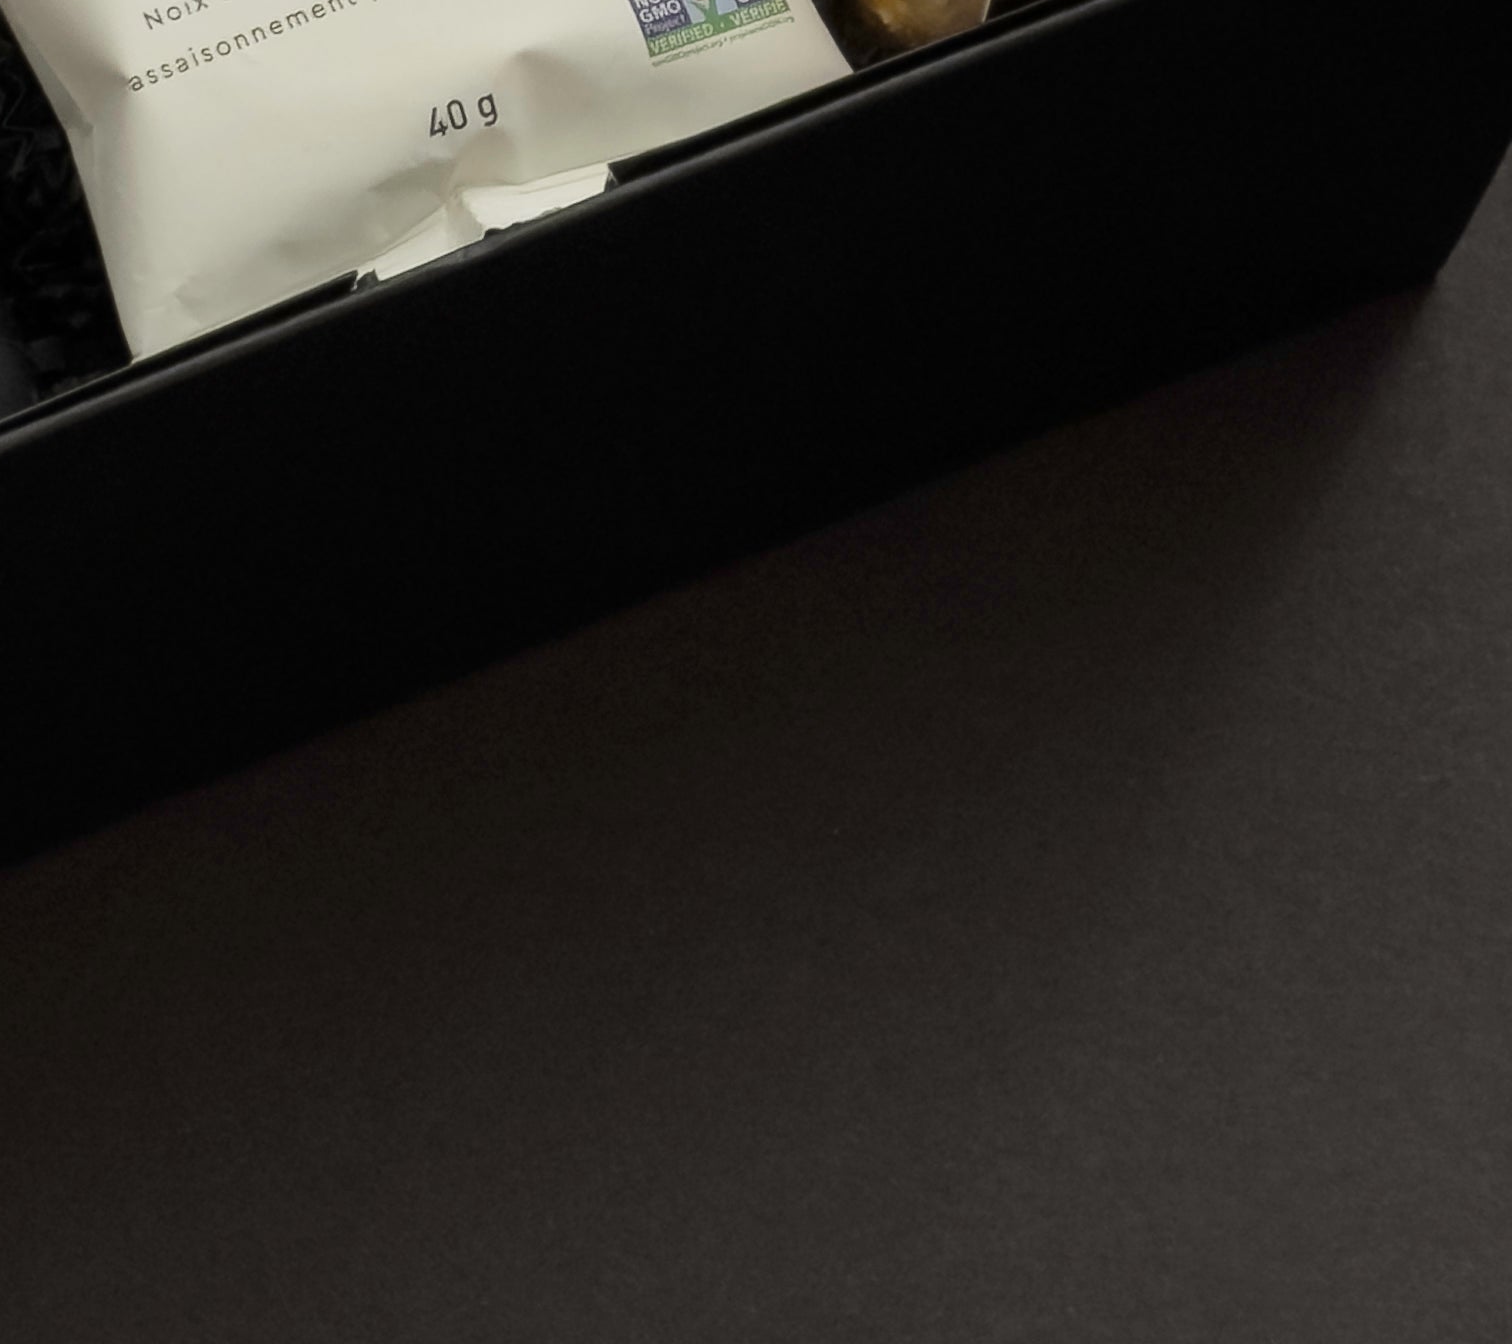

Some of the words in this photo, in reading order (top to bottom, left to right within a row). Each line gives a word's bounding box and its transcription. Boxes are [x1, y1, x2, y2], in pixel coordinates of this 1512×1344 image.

[639, 0, 681, 23] GMO
[649, 23, 713, 54] VERIFIED
[428, 99, 468, 138] 40
[477, 91, 498, 126] g
